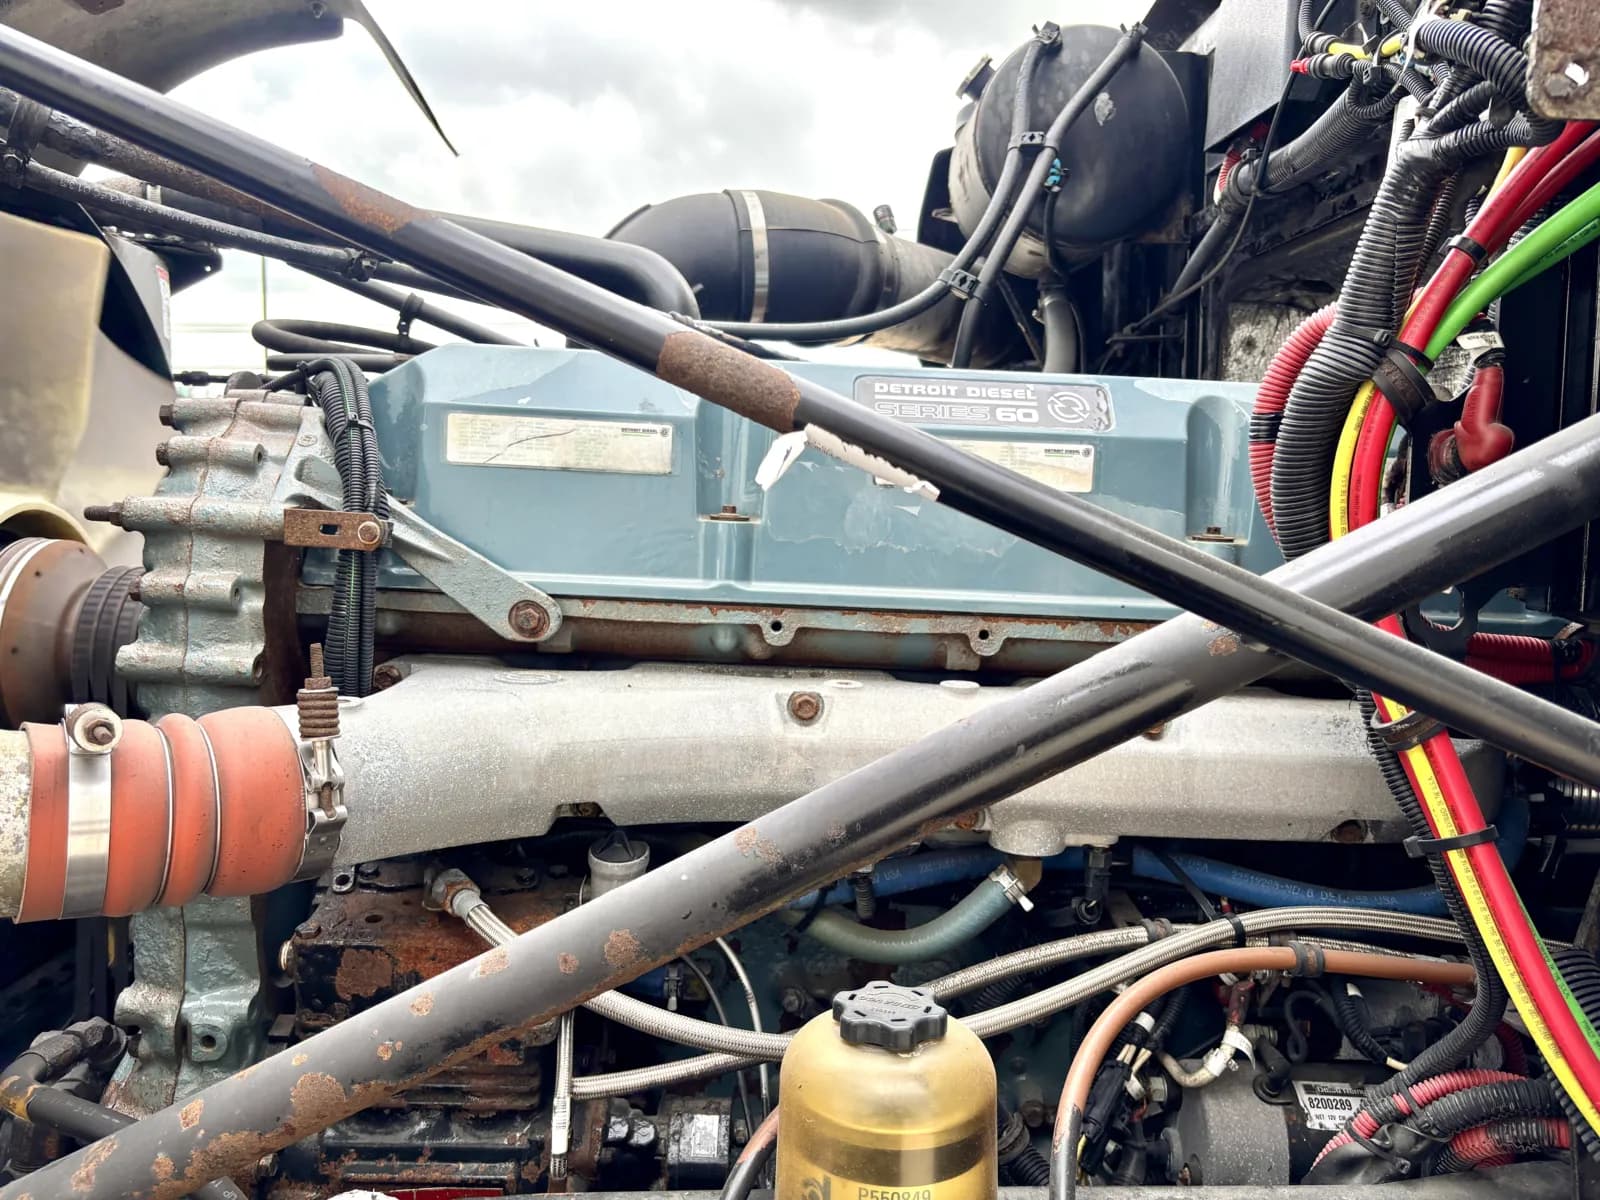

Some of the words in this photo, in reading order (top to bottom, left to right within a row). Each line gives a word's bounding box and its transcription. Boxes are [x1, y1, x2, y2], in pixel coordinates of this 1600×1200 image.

[874, 382, 958, 396] DETROIT
[966, 386, 1037, 399] DIESEL
[874, 401, 991, 421] SERIES
[996, 407, 1039, 422] 60
[1308, 1097, 1352, 1111] 8200289
